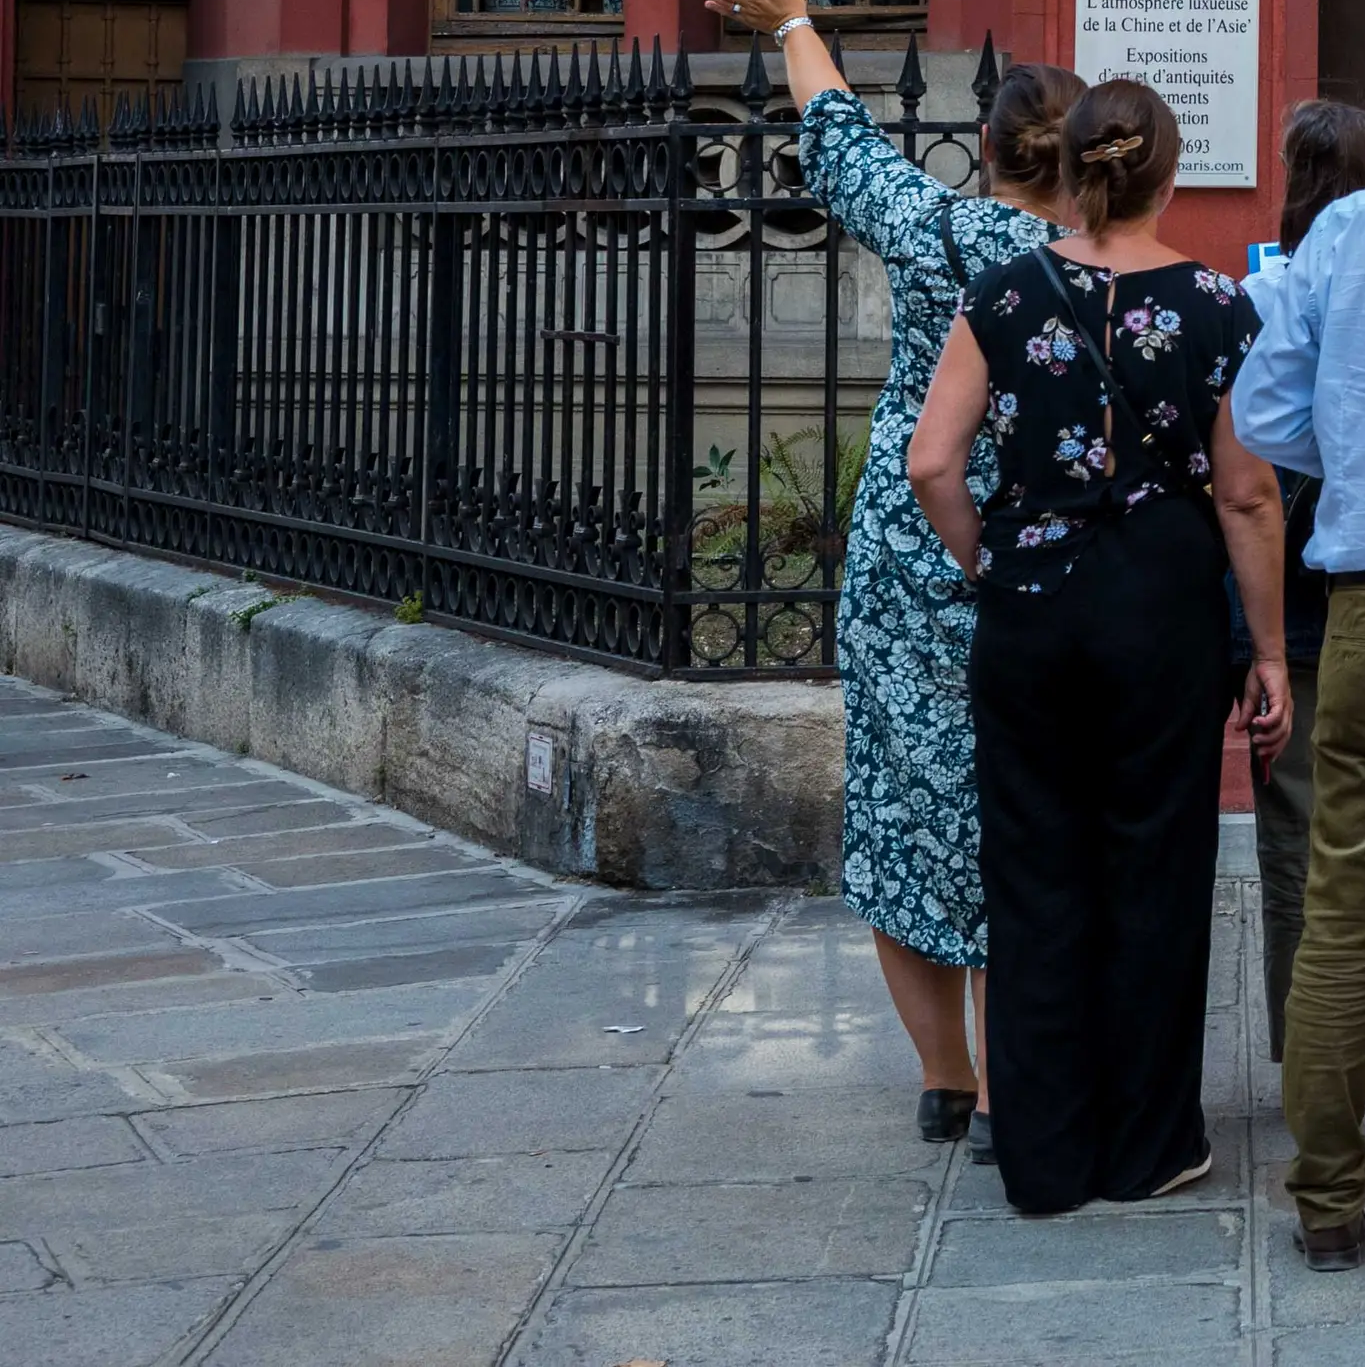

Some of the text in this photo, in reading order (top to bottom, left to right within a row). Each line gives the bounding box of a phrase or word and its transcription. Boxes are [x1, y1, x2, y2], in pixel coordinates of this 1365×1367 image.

[1083, 17, 1100, 32] de
[1105, 17, 1117, 32] la
[1121, 17, 1164, 33] Chine
[1168, 20, 1181, 33] et
[1186, 18, 1203, 33] de
[1126, 47, 1208, 65] Expositions
[1153, 69, 1235, 86] d'antiquités
[1160, 92, 1209, 105] ements
[1177, 160, 1244, 173] paris.com
